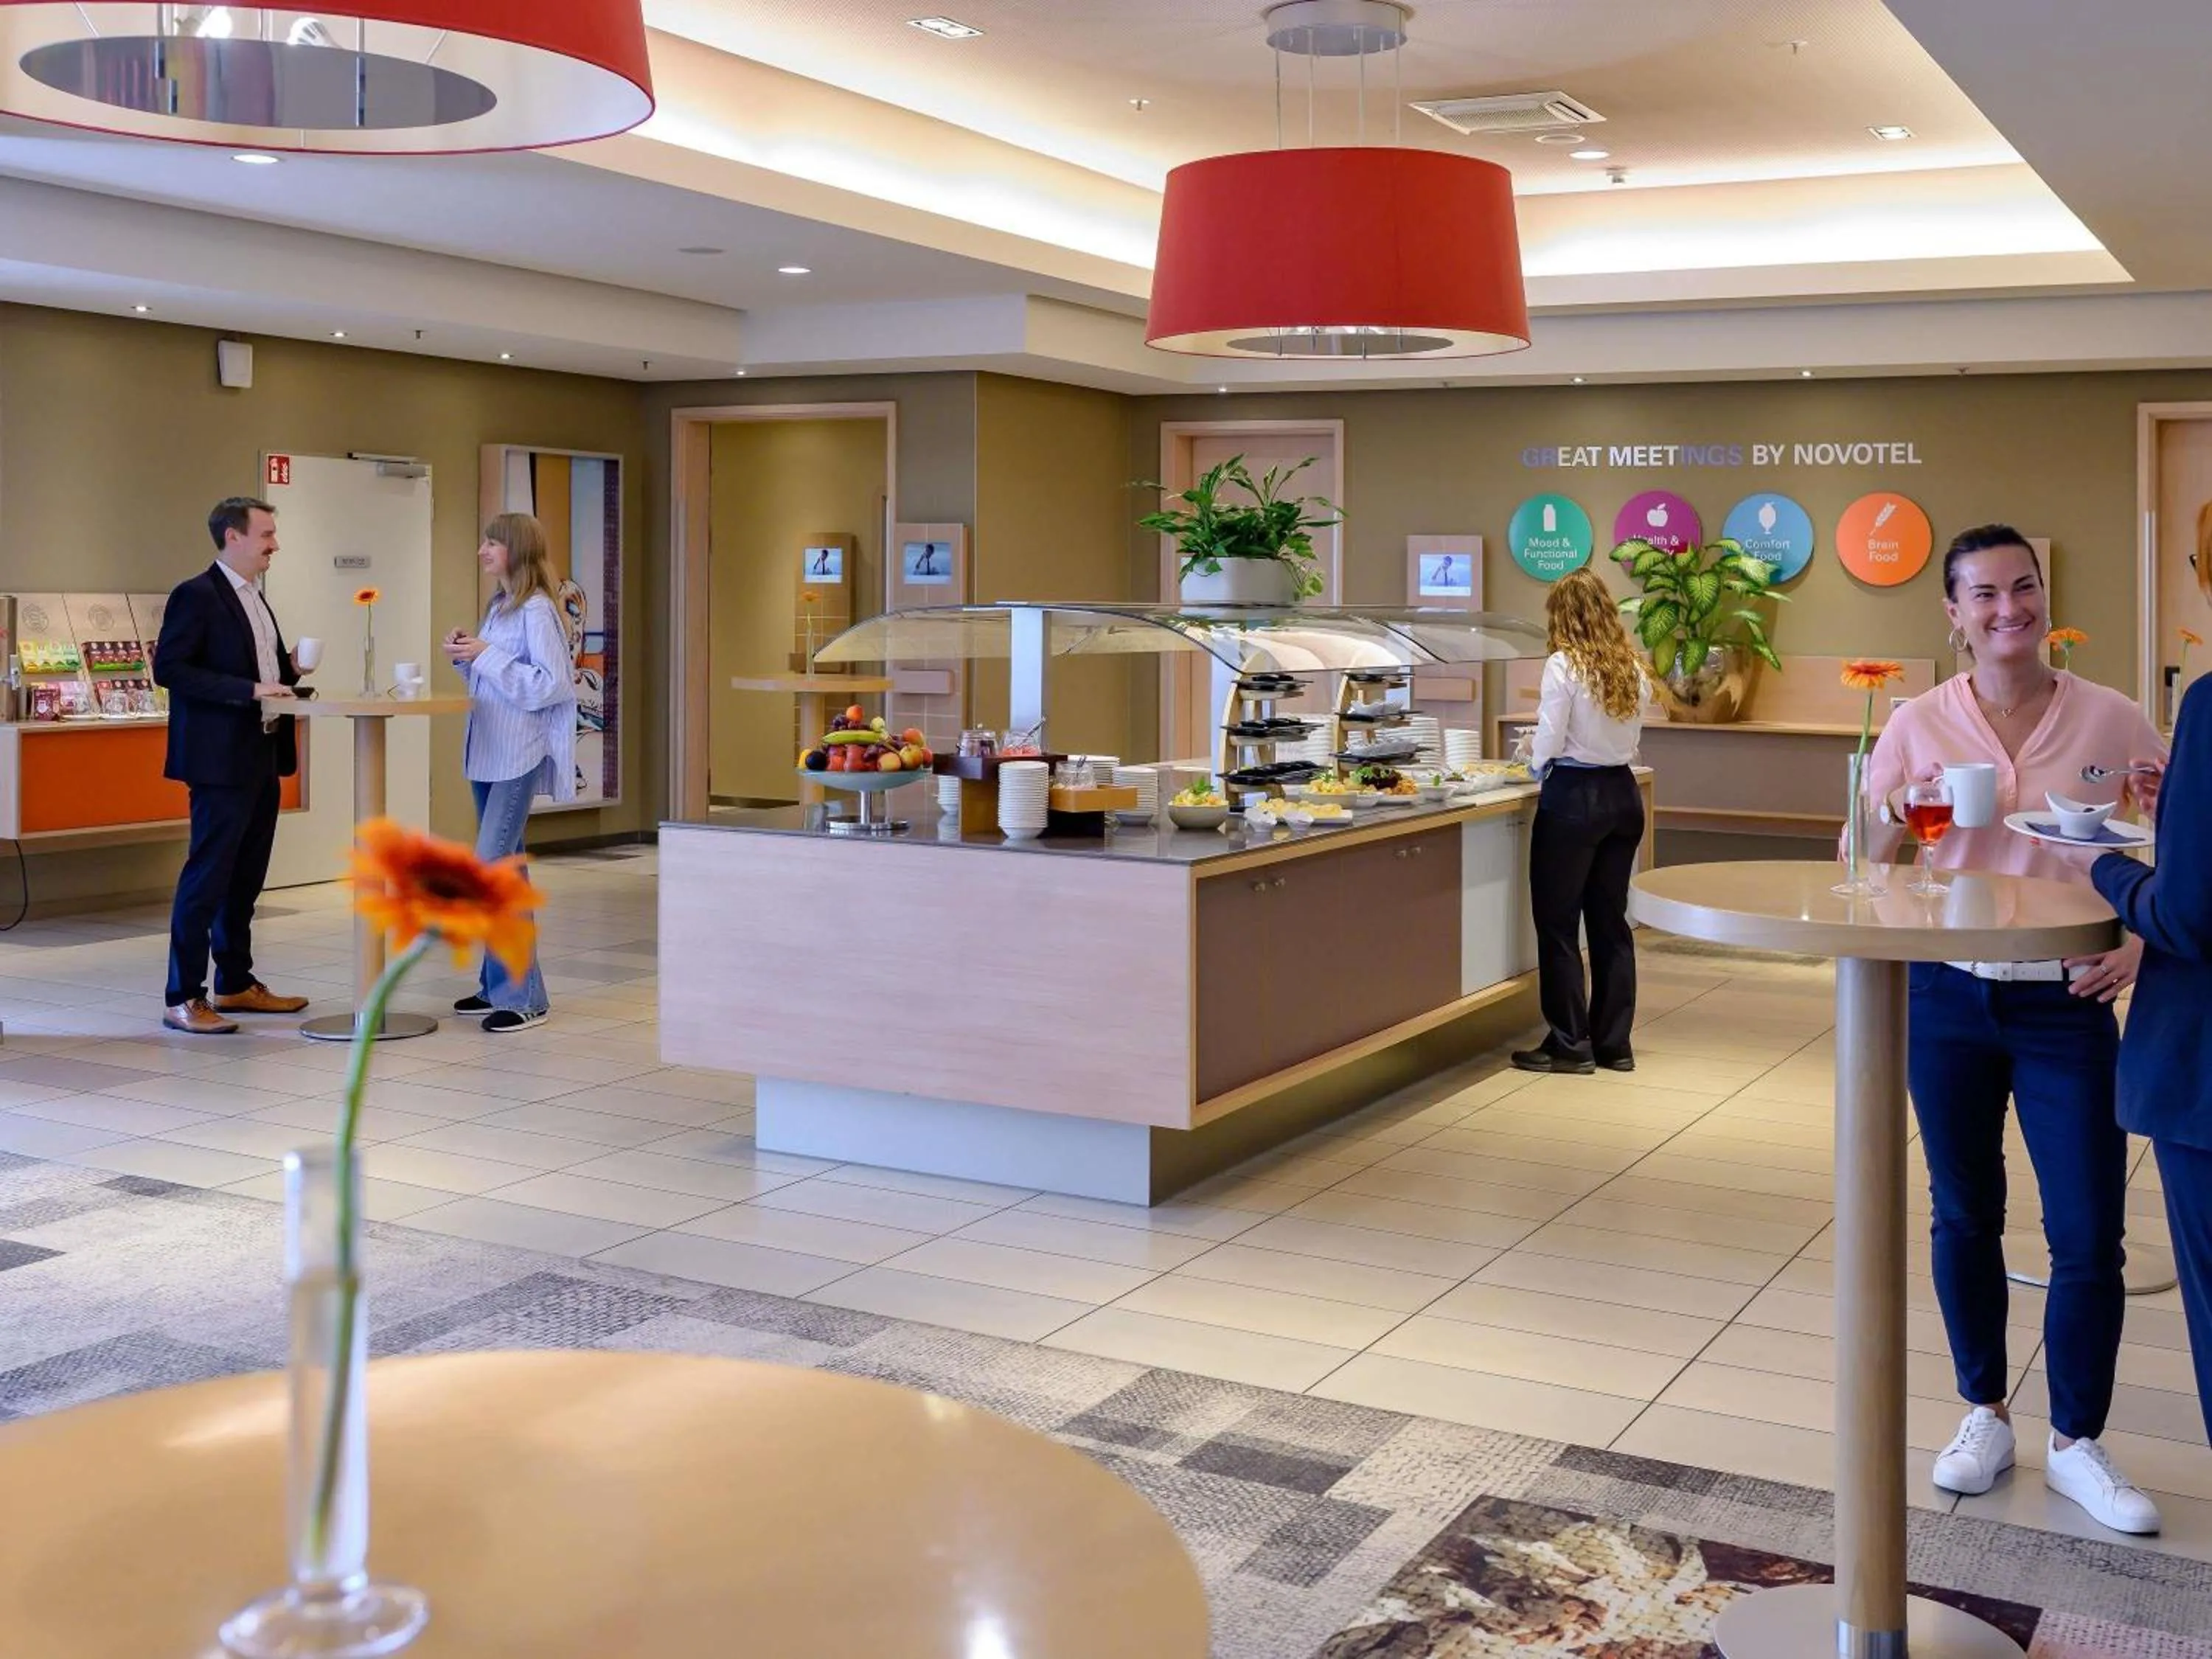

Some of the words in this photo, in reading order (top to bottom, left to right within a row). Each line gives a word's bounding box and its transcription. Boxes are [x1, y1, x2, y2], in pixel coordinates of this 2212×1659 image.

[1522, 446, 1601, 467] GREAT
[1610, 444, 1743, 467] MEETINGS
[1753, 444, 1785, 465] BY
[1794, 442, 1922, 465] NOVOTEL
[1528, 538, 1560, 547] Mood
[1562, 538, 1571, 547] &
[1670, 535, 1679, 546] &
[1745, 539, 1790, 550] Comfort
[1868, 539, 1899, 549] Brain
[1524, 548, 1577, 558] Functional
[1754, 551, 1782, 561] Food
[1869, 551, 1899, 562] Food
[1538, 560, 1564, 570] Food
